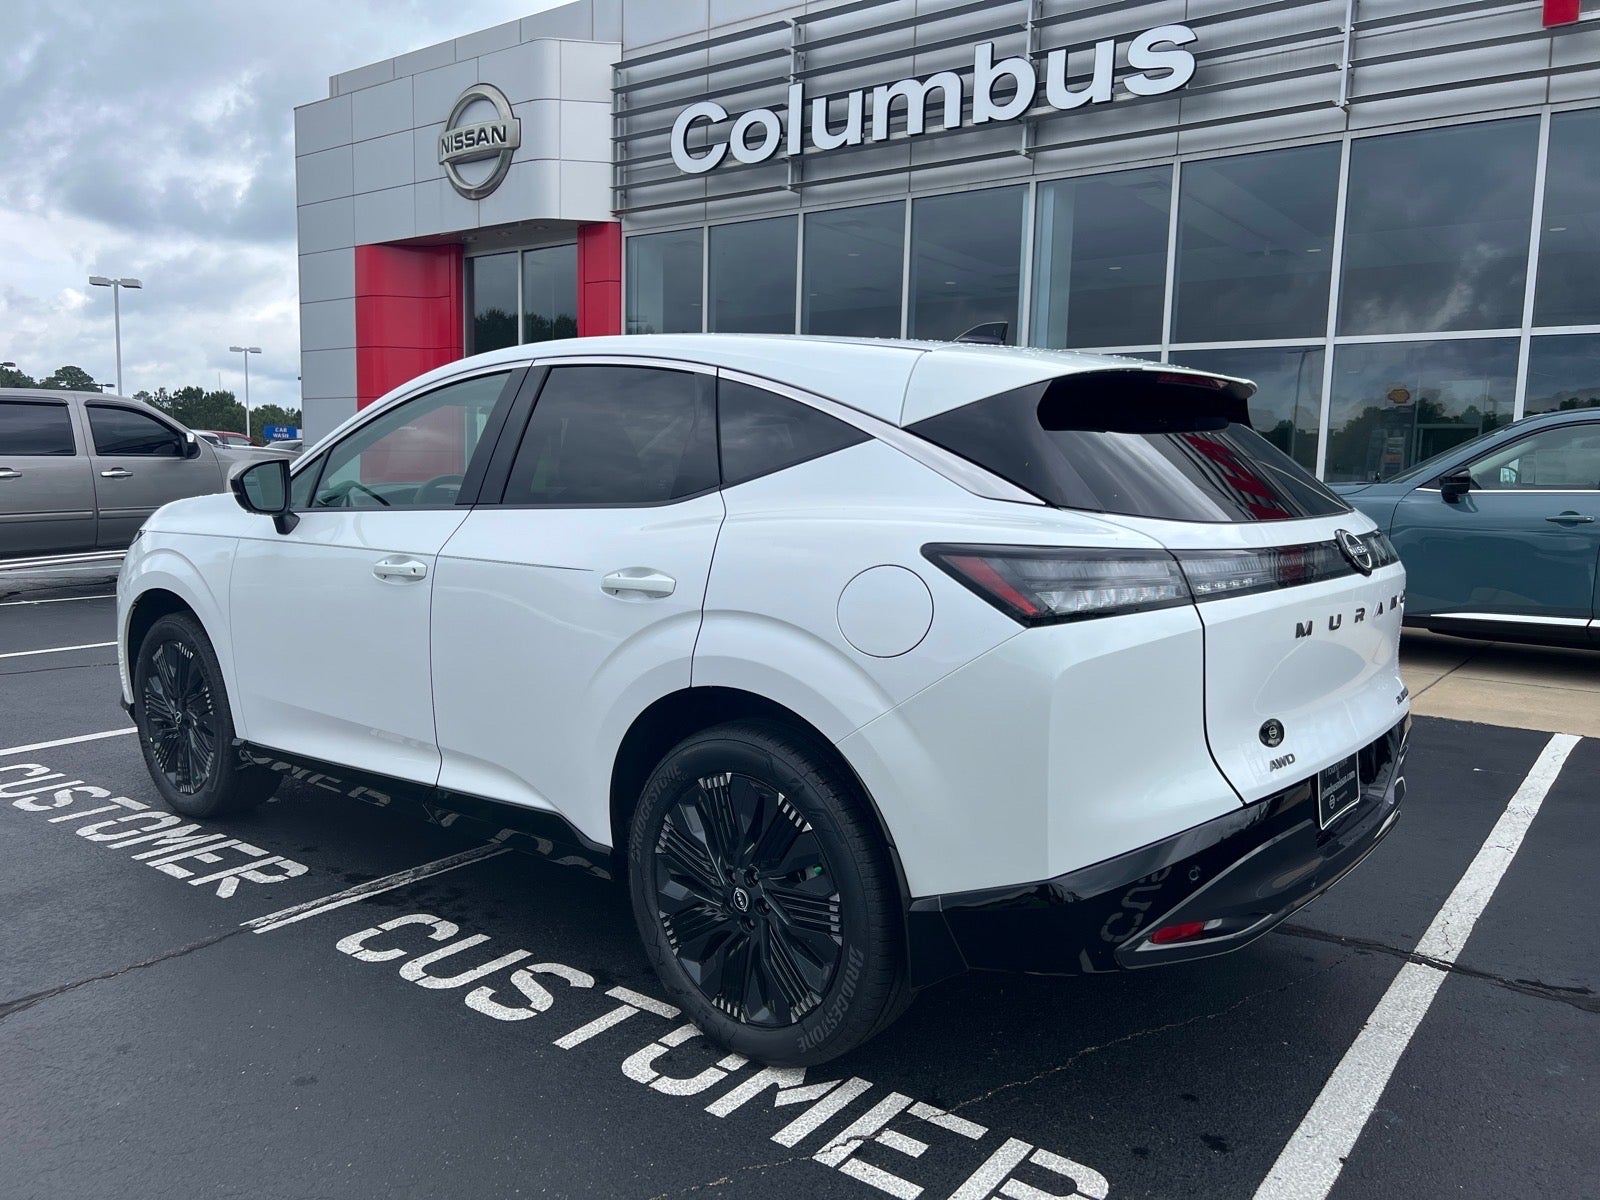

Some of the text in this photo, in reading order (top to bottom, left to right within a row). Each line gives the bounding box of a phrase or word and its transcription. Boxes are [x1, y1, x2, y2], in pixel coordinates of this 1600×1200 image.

[441, 125, 507, 156] NISSAN
[670, 24, 1198, 175] Columbus
[1269, 753, 1296, 772] AWD
[798, 943, 865, 1054] BRIDGESTONE
[335, 913, 1109, 1200] CUSTOMER
